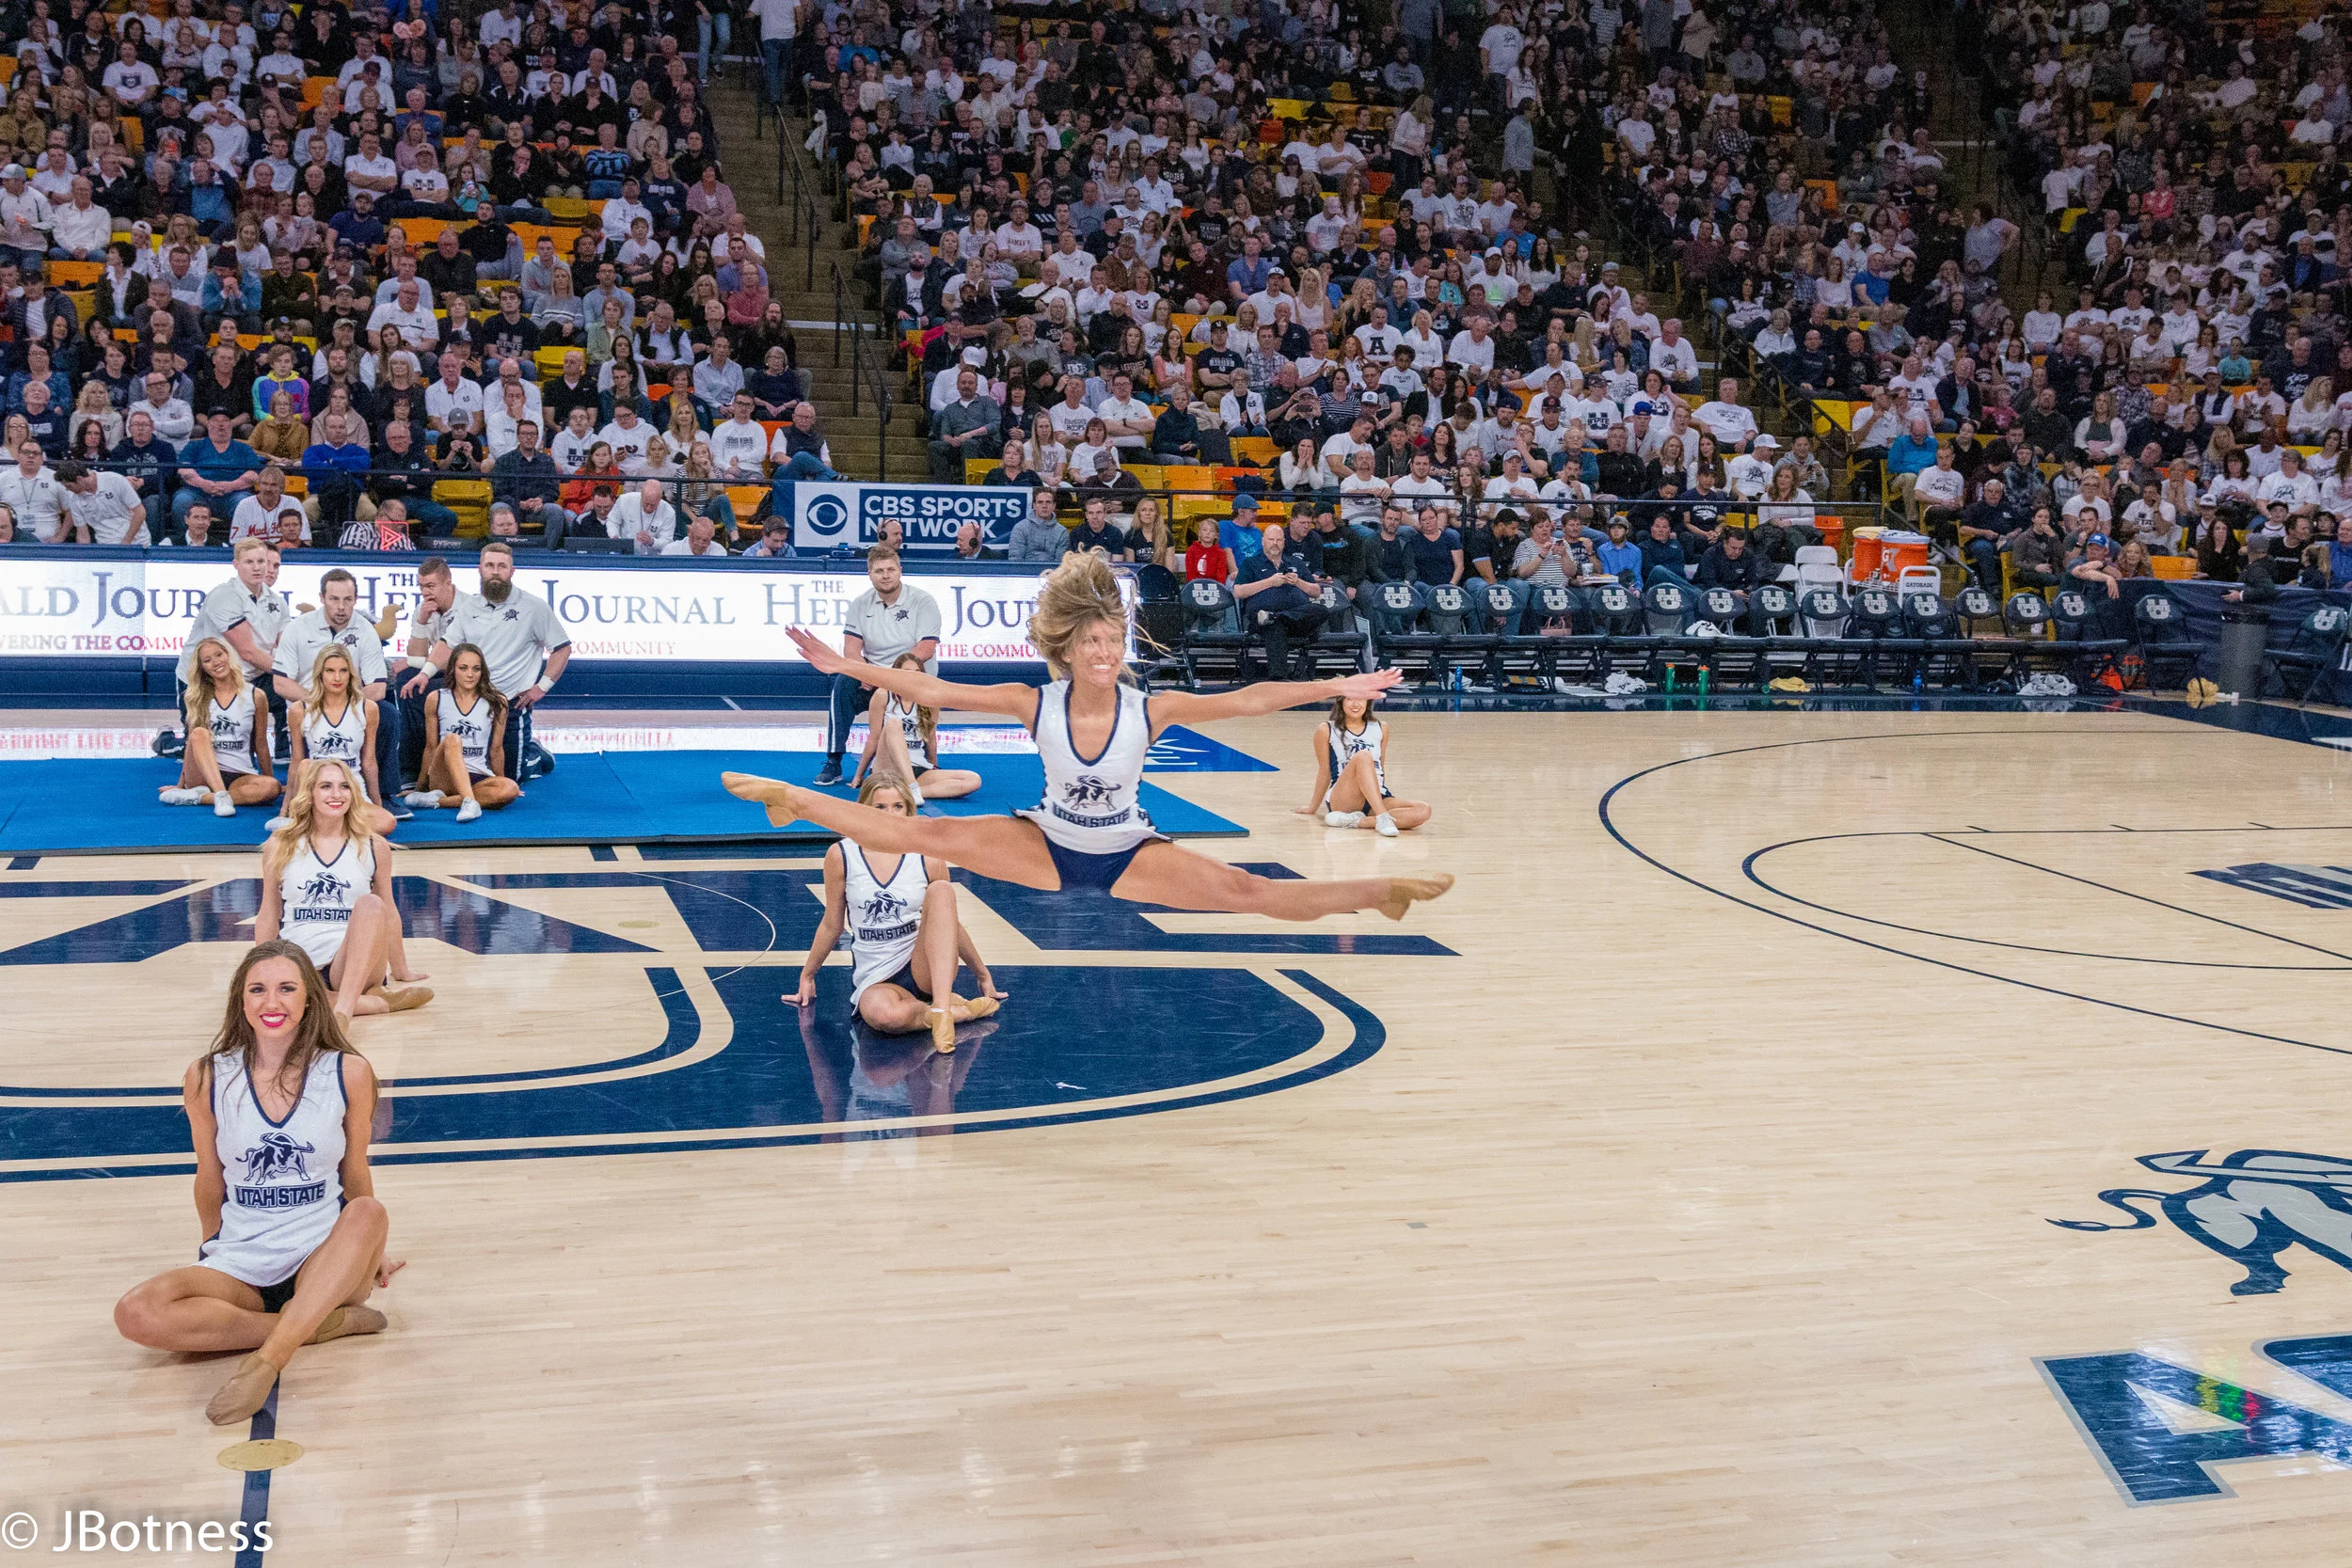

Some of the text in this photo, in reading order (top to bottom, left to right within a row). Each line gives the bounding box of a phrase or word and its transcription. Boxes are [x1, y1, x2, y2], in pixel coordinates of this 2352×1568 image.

[1367, 336, 1388, 356] A
[865, 495, 1022, 518] CBS SPORTS
[865, 516, 997, 539] NTWOK
[389, 573, 421, 587] TH
[811, 579, 845, 594] THE
[91, 572, 206, 628] JOUR
[542, 579, 736, 625] JOURNAL
[762, 583, 851, 626] HER
[0, 634, 66, 651] ERING
[72, 635, 112, 651] THE
[937, 644, 968, 657] THE
[973, 644, 1040, 658] COMMU
[222, 740, 244, 750] STATE
[462, 747, 484, 756] STATE
[1054, 802, 1130, 828] UTAH STATE
[294, 908, 353, 921] UTAH STAT
[858, 920, 917, 941] UTAH STATE
[235, 1181, 326, 1208] UTAH STATE
